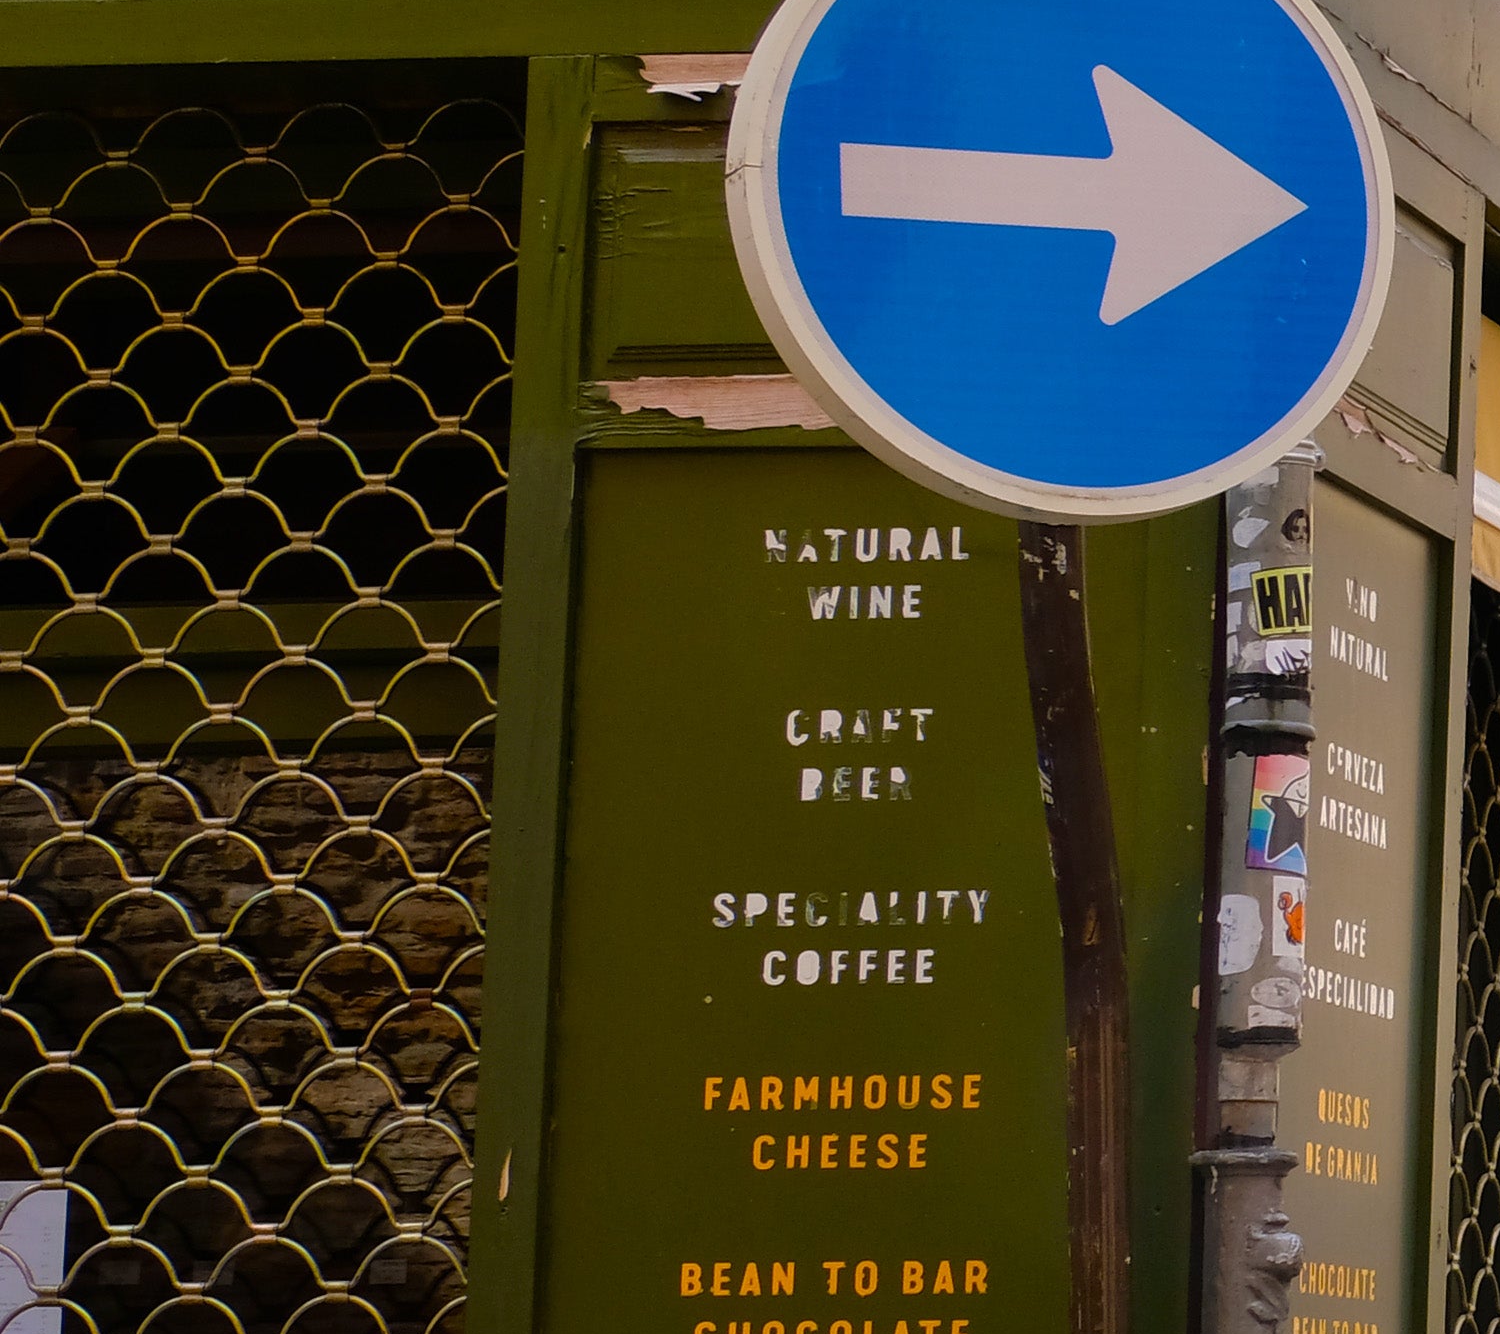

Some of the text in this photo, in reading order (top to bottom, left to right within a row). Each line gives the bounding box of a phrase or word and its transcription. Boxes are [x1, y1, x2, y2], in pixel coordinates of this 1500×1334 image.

[764, 527, 970, 563] NATURAL
[807, 585, 922, 620] WINE
[1330, 625, 1388, 682] NATURAL
[786, 709, 934, 746] CRAFT
[800, 767, 912, 801] BEER
[1327, 742, 1384, 796] CERVEZA
[1319, 795, 1387, 850] ARTESANA
[712, 889, 990, 928] SPECIALITY
[1334, 919, 1367, 958] CAFÉ
[762, 948, 935, 986] COFFEE
[1300, 965, 1395, 1020] ESPECIALIDAD
[704, 1074, 982, 1111] FARMHOUSE
[1317, 1088, 1371, 1130] QUESOS
[752, 1134, 928, 1170] CHEESE
[1305, 1141, 1378, 1186] DE GRANJA
[680, 1259, 989, 1296] BEAN TO BAR
[1299, 1262, 1376, 1302] CHOCOLATE
